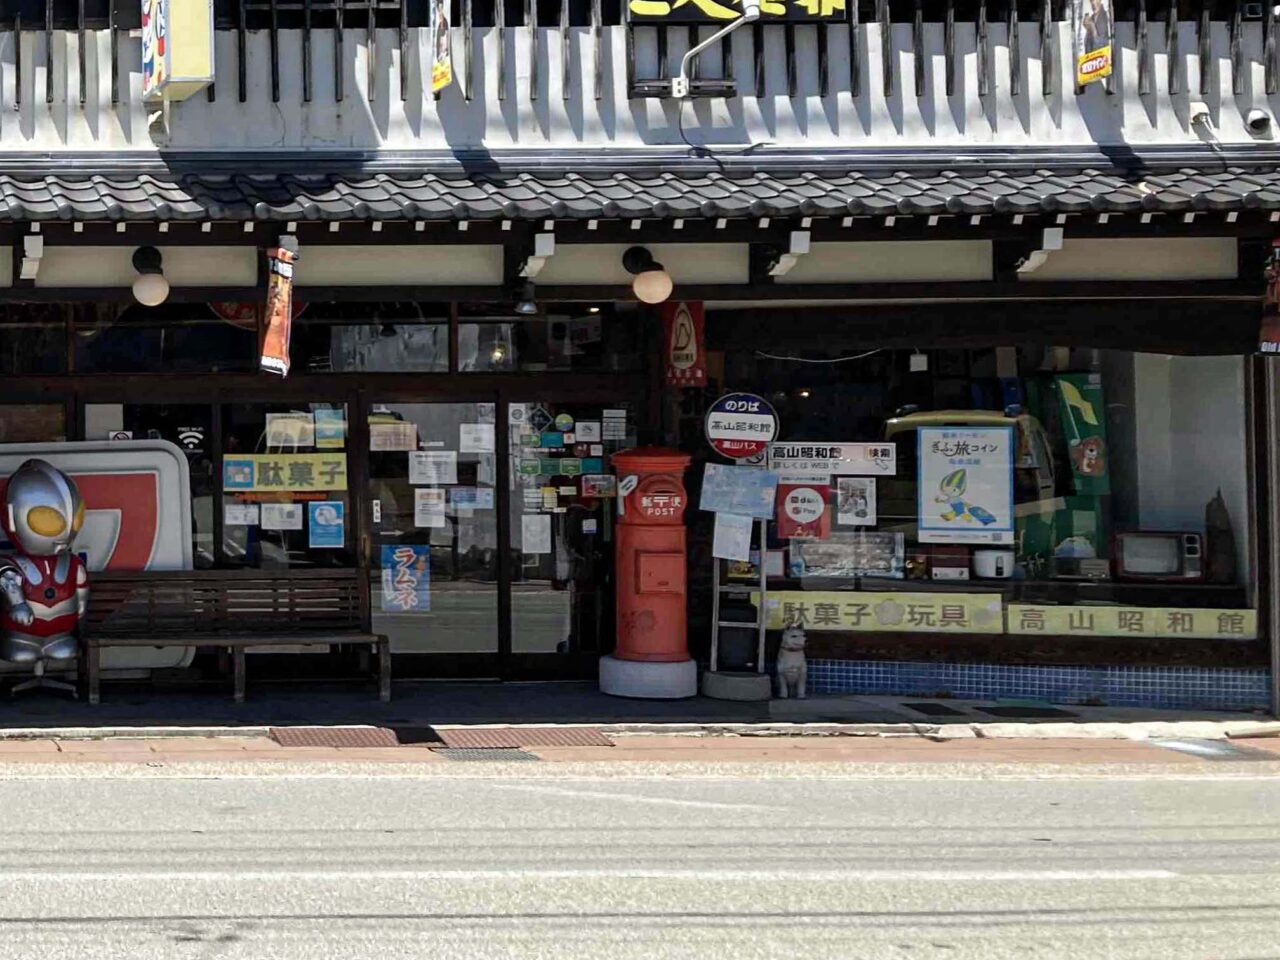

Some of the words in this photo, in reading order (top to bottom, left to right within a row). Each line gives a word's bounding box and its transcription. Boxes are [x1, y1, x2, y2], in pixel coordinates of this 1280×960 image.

[725, 400, 761, 413] のりば
[257, 461, 345, 487] 駄菓子
[647, 507, 675, 516] POST
[392, 547, 418, 610] ラムネ
[783, 602, 874, 627] 駄菓子
[908, 604, 969, 627] 玩具
[1020, 607, 1246, 635] 高山昭和館
